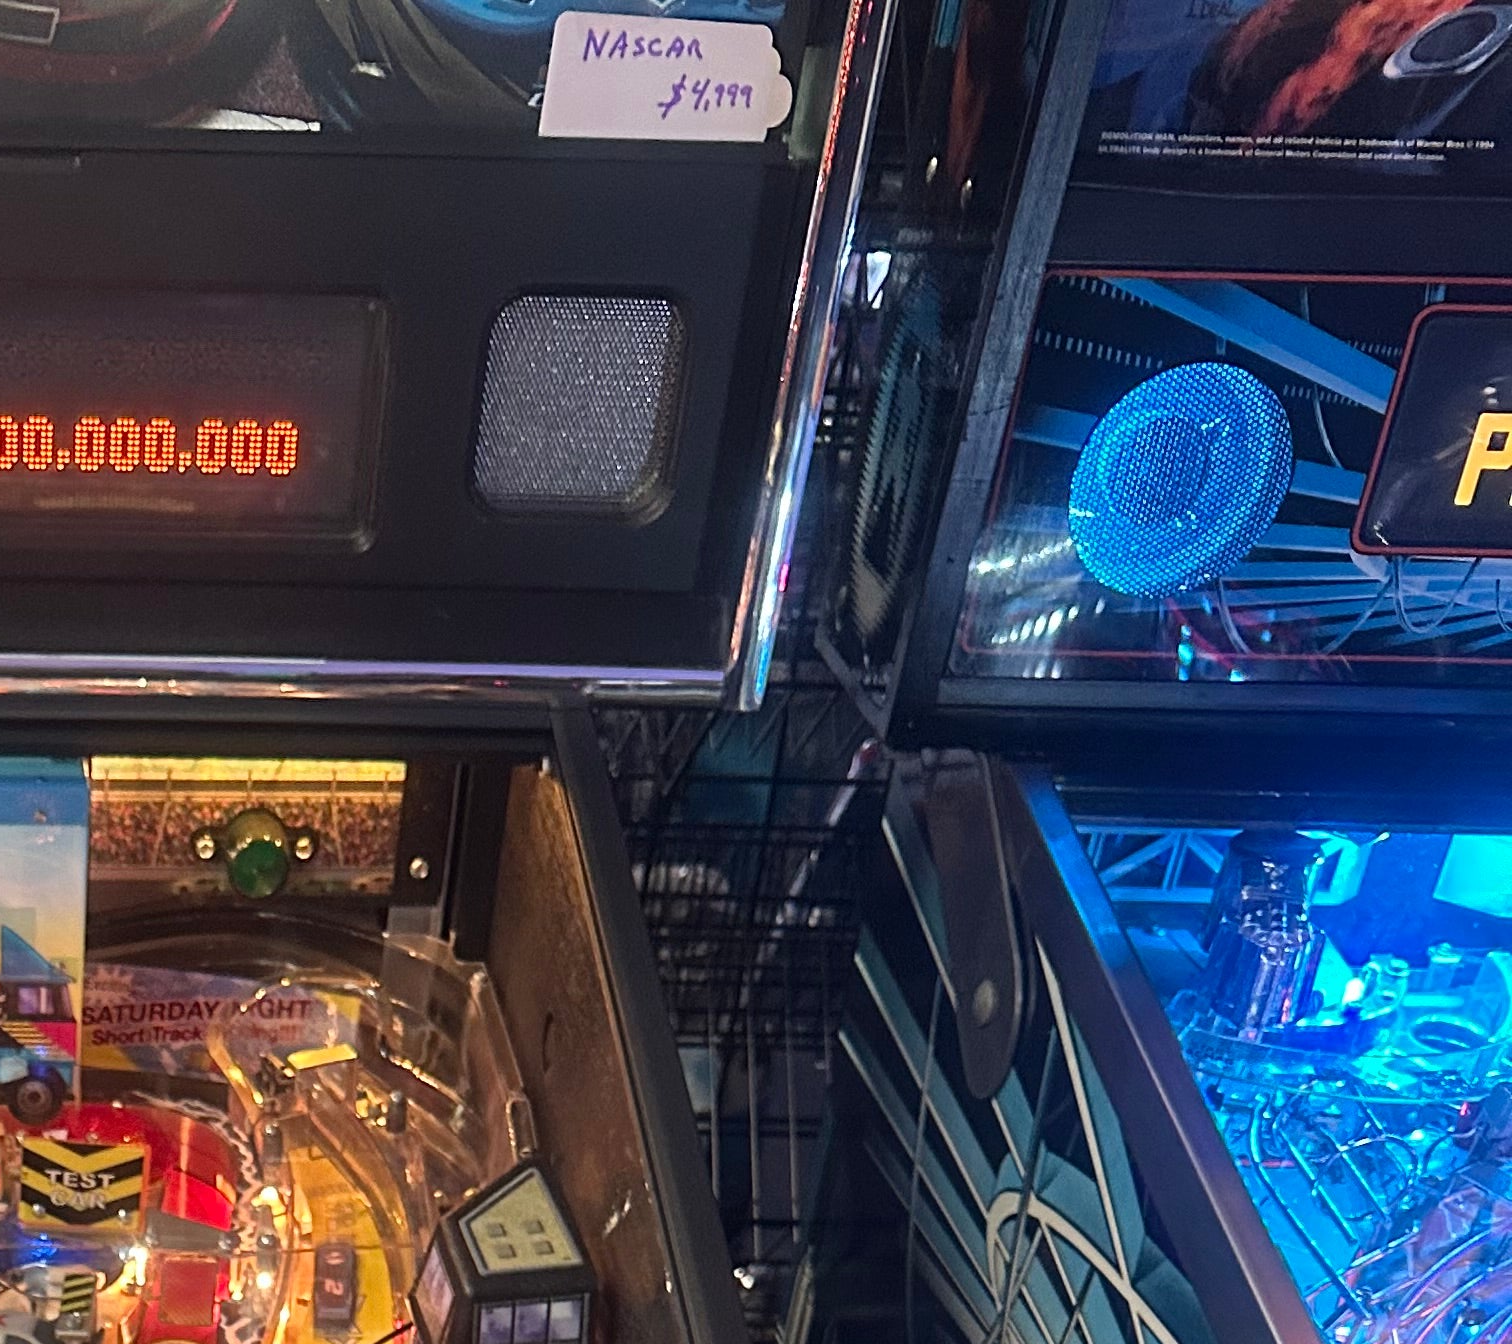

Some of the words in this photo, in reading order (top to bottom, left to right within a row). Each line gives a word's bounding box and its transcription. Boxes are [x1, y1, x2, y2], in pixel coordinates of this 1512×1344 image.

[582, 28, 704, 61] NASCAR
[657, 74, 754, 120] $4,999
[82, 999, 222, 1026] SATURDAY
[91, 1028, 145, 1046] Short
[152, 1026, 203, 1043] Track
[44, 1168, 116, 1189] TEST
[50, 1189, 106, 1211] CAR
